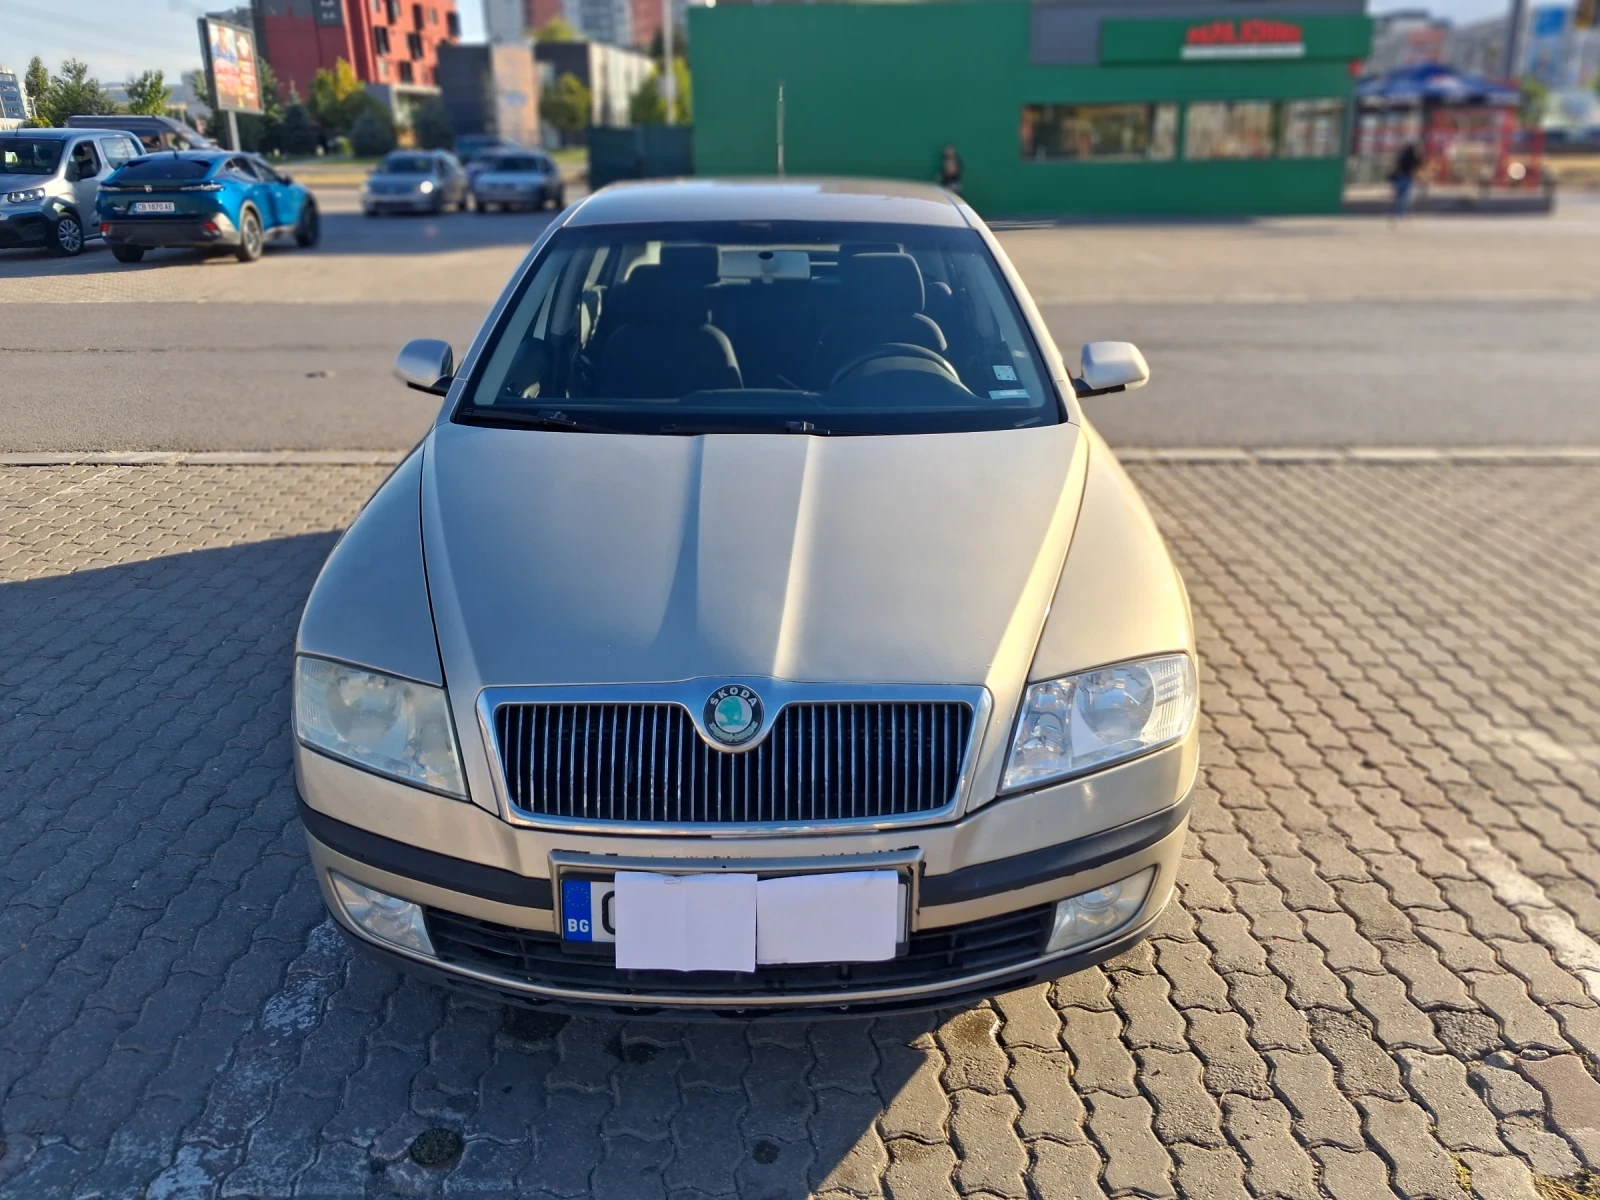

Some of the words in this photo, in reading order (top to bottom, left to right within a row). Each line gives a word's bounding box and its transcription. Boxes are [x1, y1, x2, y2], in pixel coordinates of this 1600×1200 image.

[137, 203, 147, 211] CB
[148, 203, 164, 211] 1870
[567, 918, 590, 933] BG
